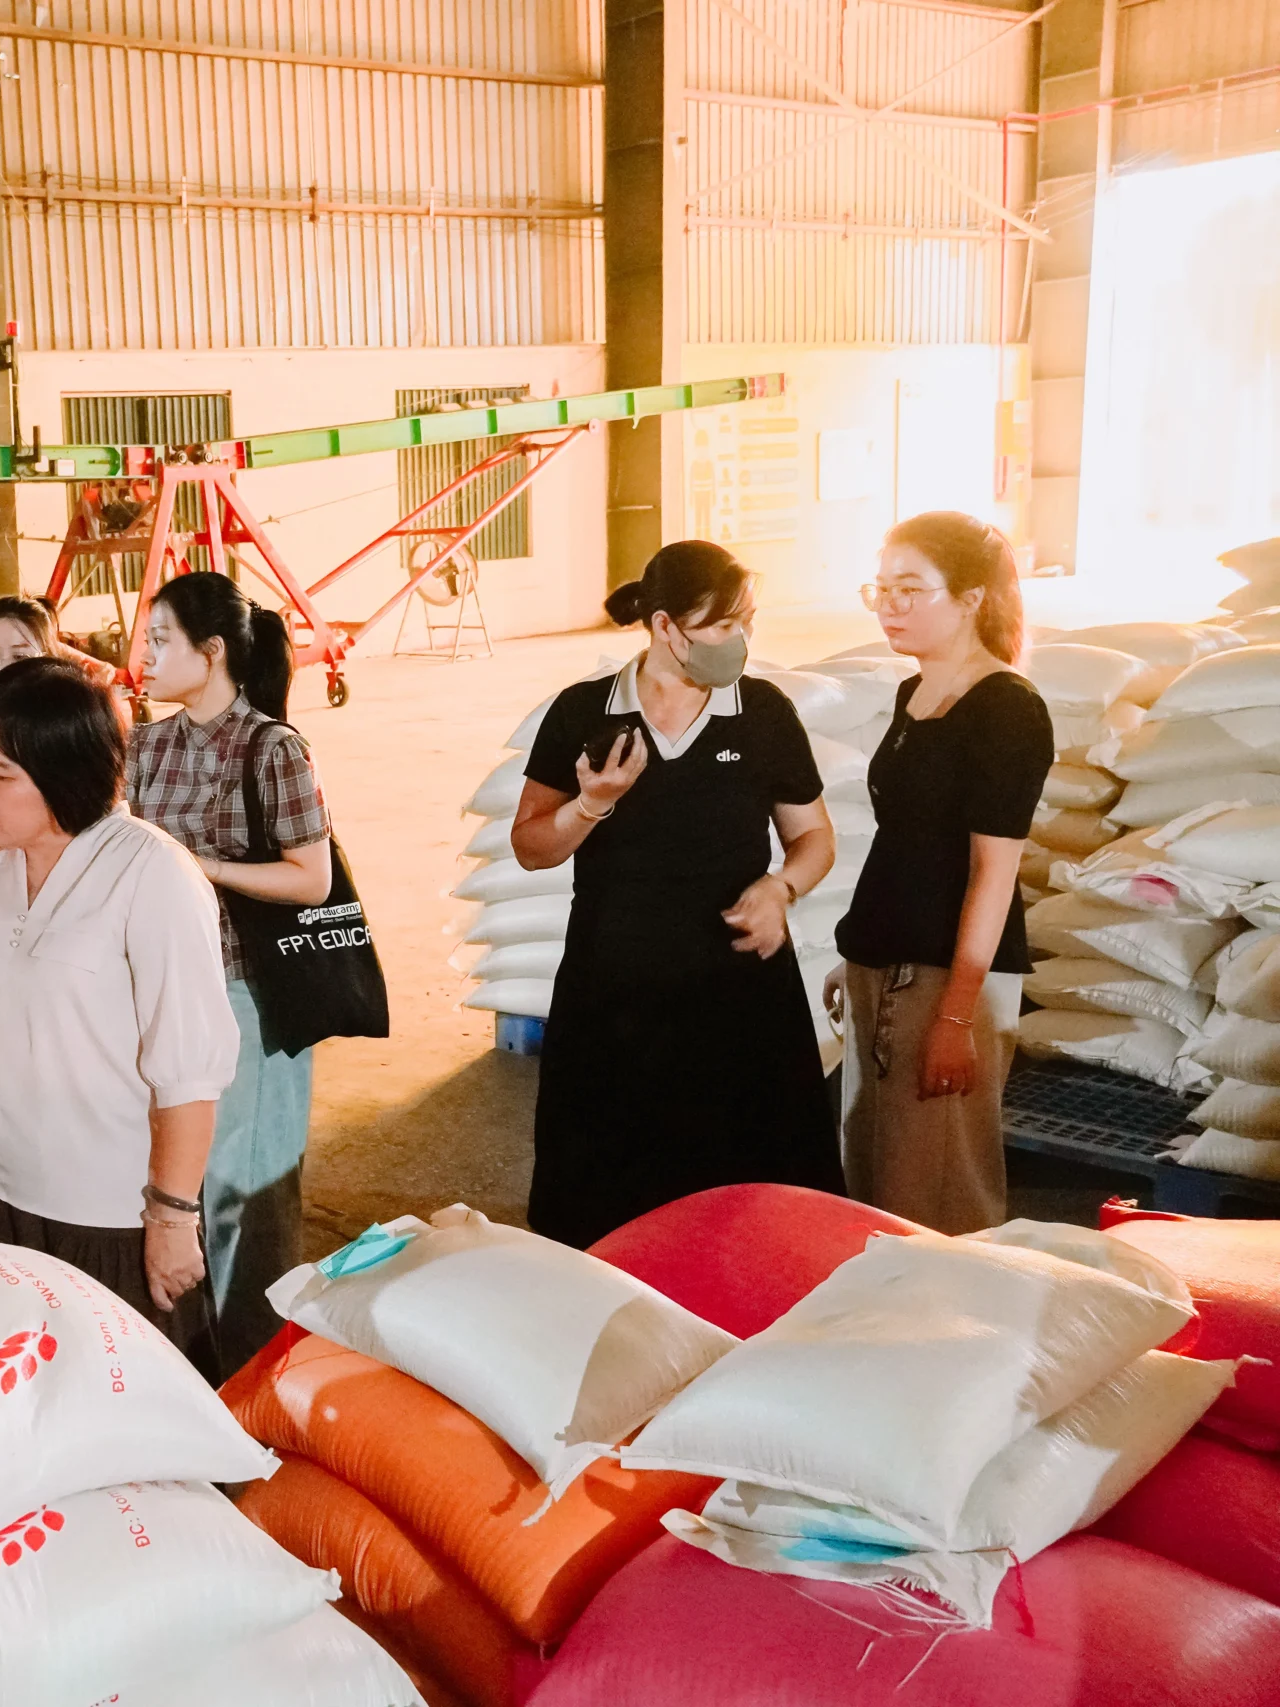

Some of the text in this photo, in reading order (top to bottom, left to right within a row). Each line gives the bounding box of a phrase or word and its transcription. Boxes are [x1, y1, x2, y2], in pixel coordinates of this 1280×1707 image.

[298, 908, 320, 925] FPT
[322, 903, 361, 917] educamp
[277, 934, 316, 955] FPT
[32, 1279, 62, 1310] CNVS
